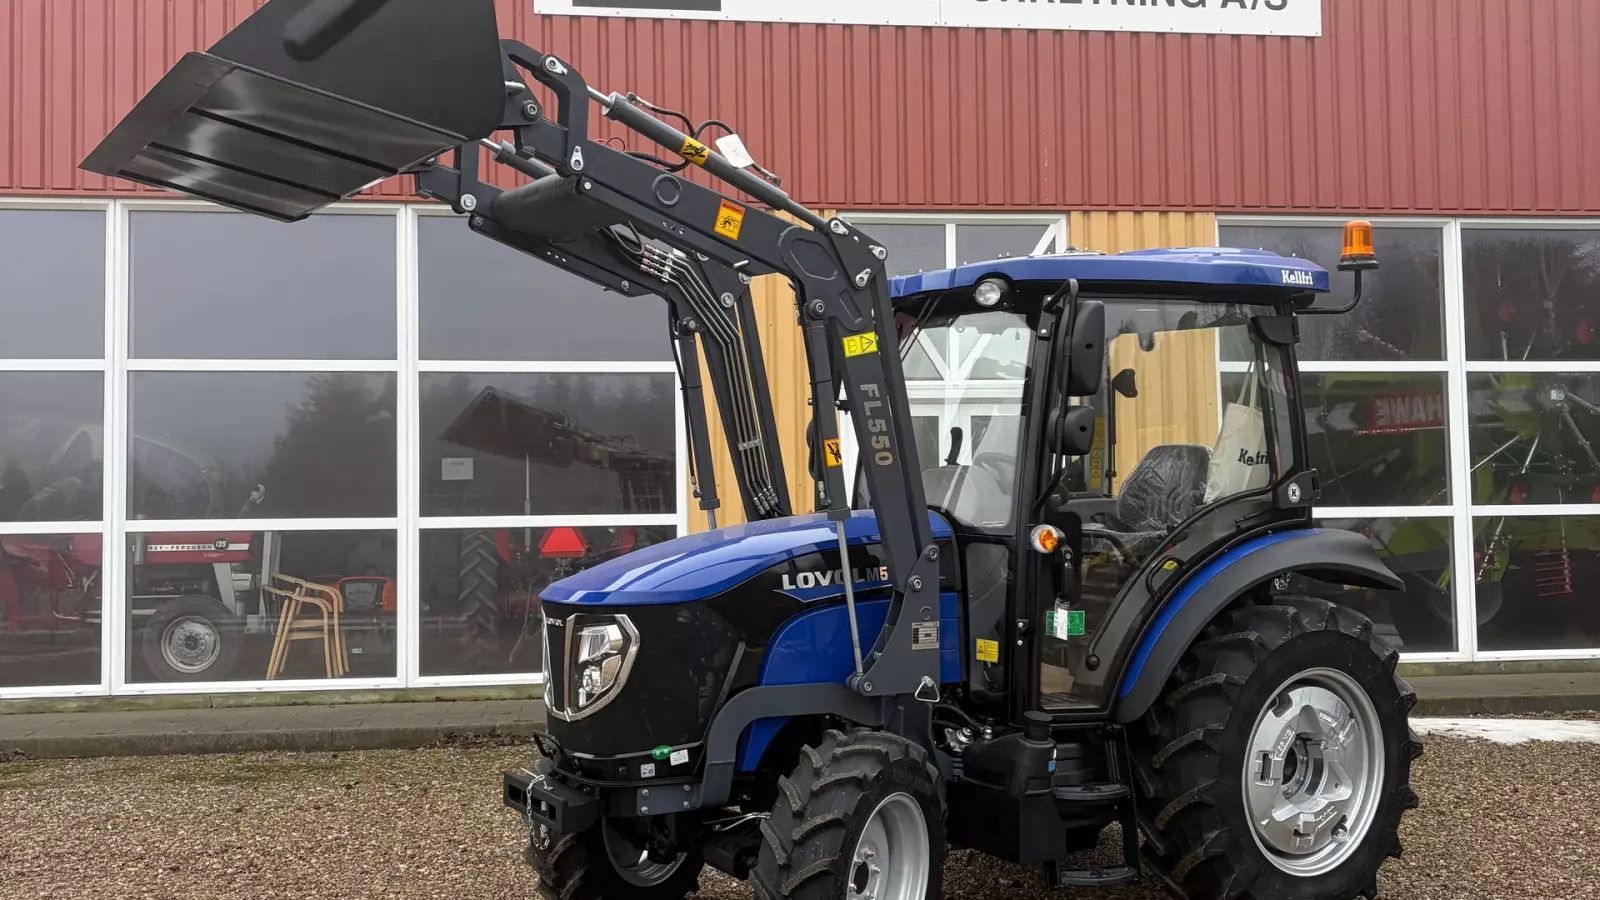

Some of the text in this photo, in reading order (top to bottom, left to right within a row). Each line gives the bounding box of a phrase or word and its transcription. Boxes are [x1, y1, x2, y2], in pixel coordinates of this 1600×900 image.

[1281, 269, 1314, 286] Kellfri
[860, 384, 893, 466] FL550
[215, 540, 227, 548] 135
